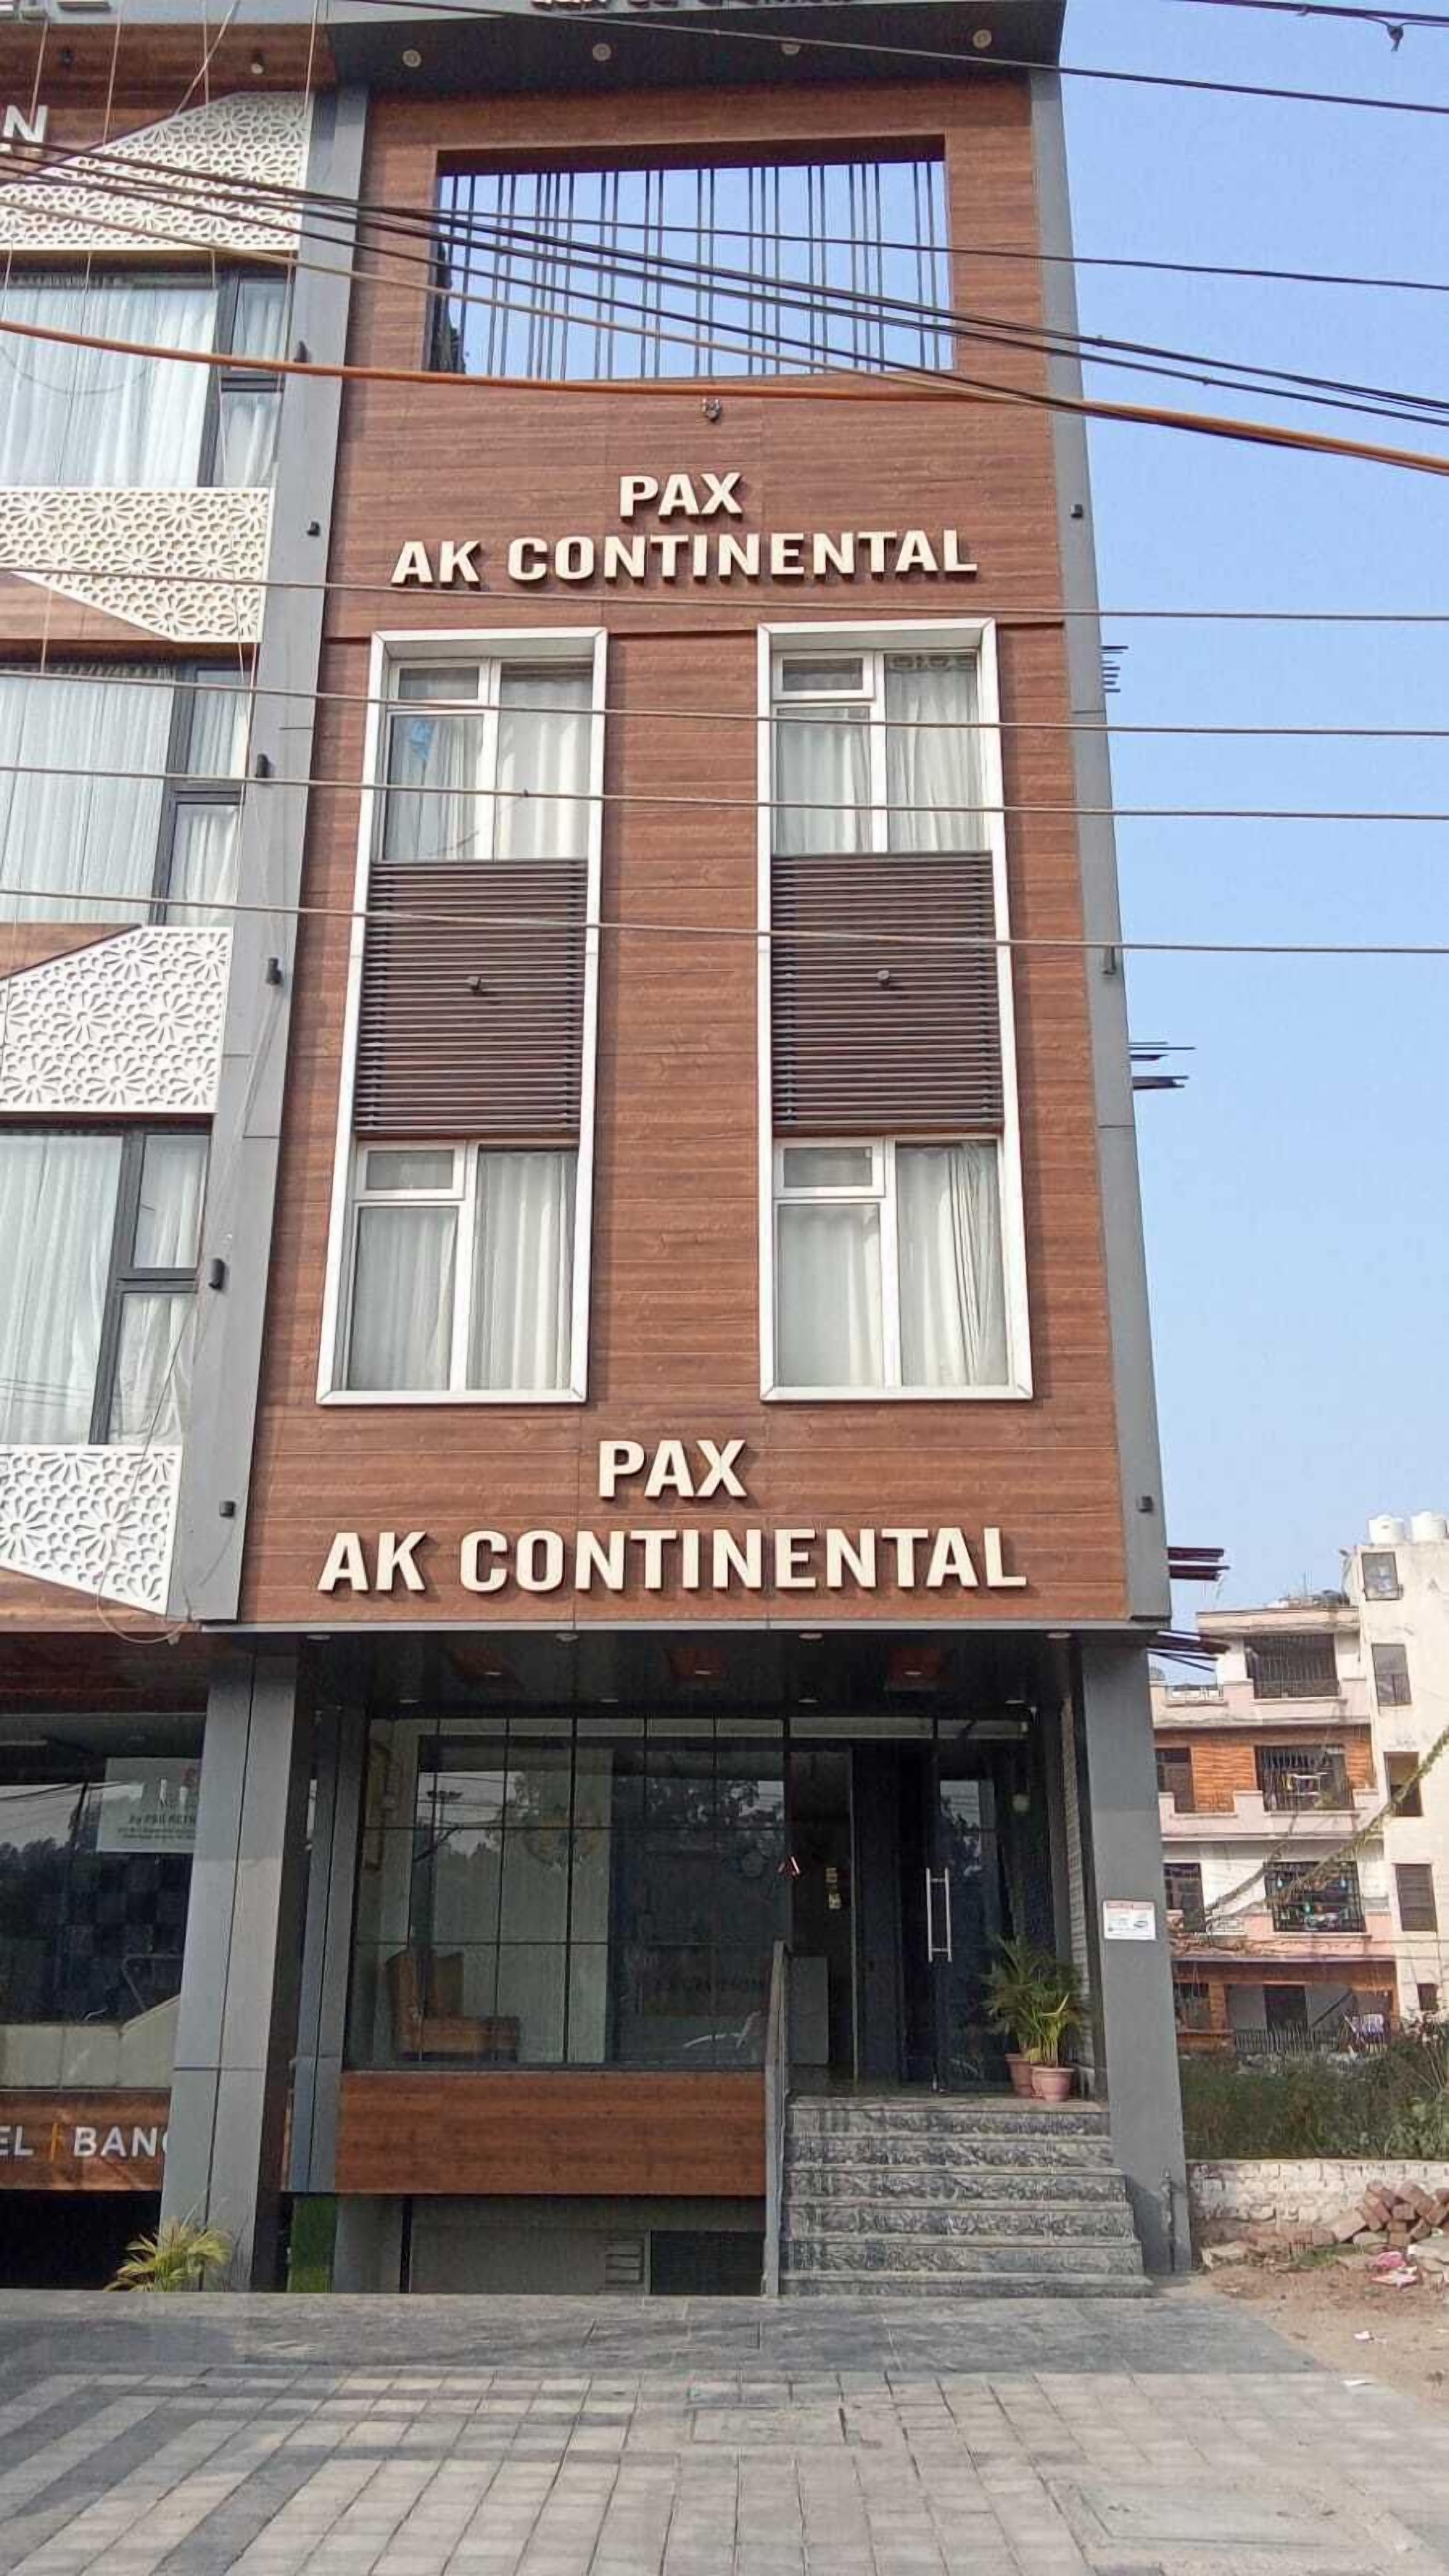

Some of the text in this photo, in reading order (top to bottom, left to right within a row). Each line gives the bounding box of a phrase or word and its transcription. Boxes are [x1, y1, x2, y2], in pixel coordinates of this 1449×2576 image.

[620, 472, 742, 517] PAX
[391, 530, 978, 584] AK CONTINENTAL
[599, 1440, 747, 1497] PAX
[317, 1527, 1027, 1592] AK CONTINENTAL
[74, 2126, 167, 2157] BAN
